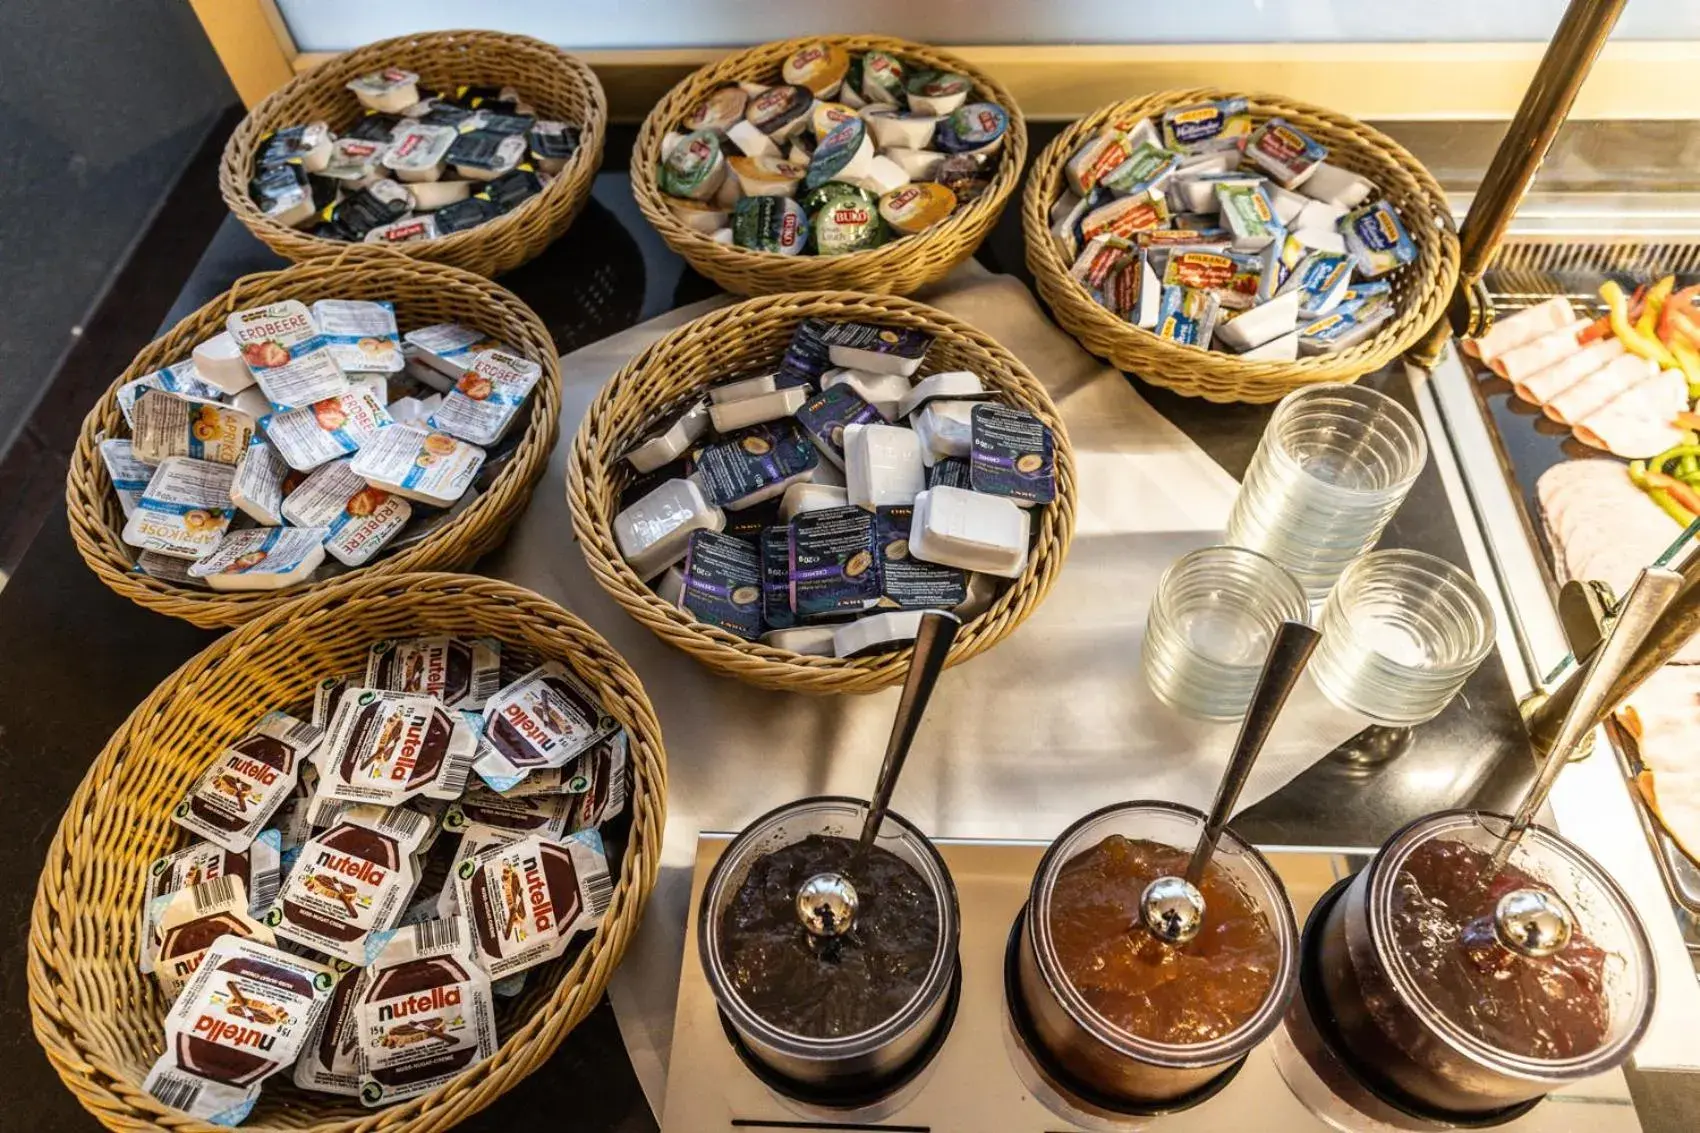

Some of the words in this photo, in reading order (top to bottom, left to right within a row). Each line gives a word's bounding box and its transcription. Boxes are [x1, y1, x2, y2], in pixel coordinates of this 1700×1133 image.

[837, 211, 866, 223] BUKO
[238, 314, 308, 342] ERDBEERE
[221, 415, 238, 460] APRIKO
[343, 499, 399, 555] ERDBEERE
[503, 703, 556, 752] nutella
[391, 715, 427, 781] nutella
[226, 756, 277, 786] nutella
[317, 851, 386, 887] nutella
[523, 856, 552, 933] nutella
[378, 987, 462, 1022] nutella
[195, 1014, 277, 1052] nutella
